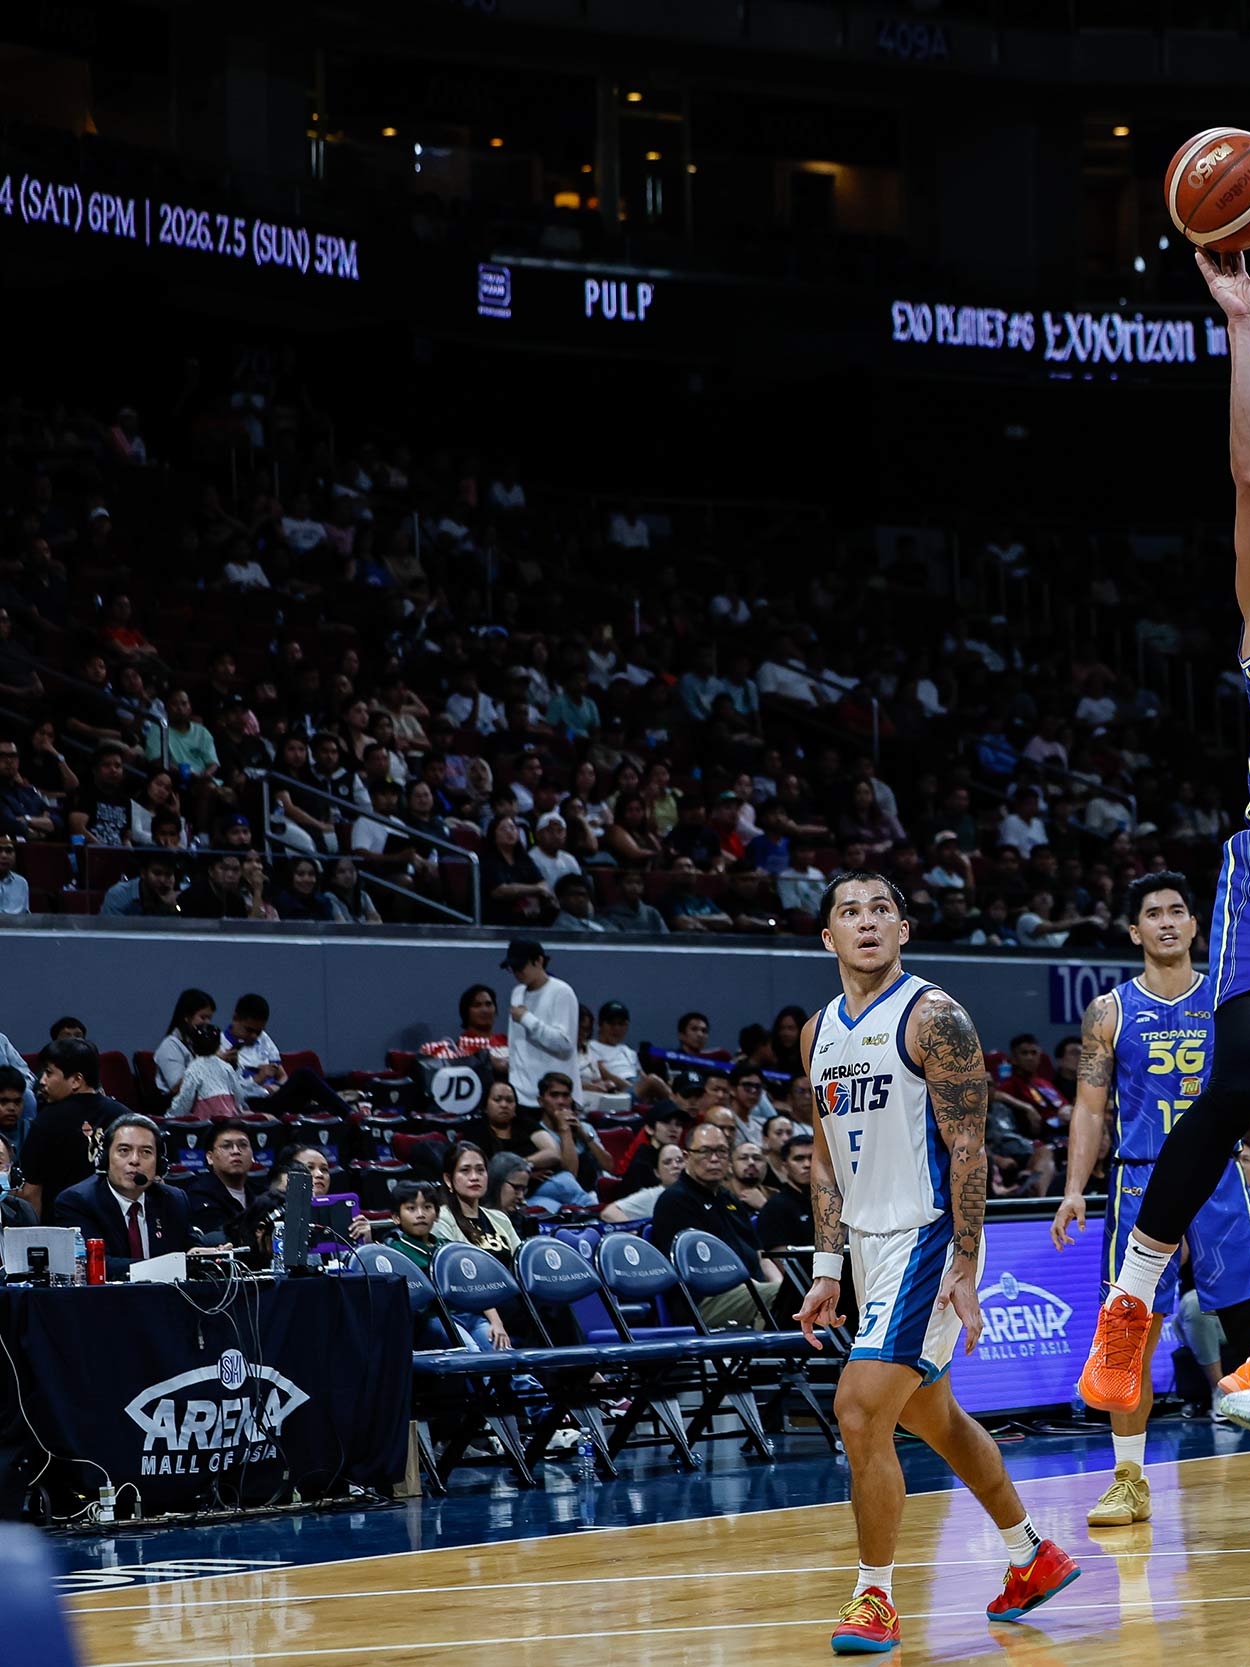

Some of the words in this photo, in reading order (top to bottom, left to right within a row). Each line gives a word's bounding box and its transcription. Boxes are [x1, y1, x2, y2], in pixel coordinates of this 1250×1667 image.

[20, 173, 83, 233] (SAT)
[88, 191, 136, 239] 6PM
[159, 203, 246, 258] 2026.7.5
[252, 218, 310, 275] (SUN)
[314, 233, 359, 281] 5PM
[585, 278, 652, 321] PULP
[892, 300, 933, 343] EXO
[1140, 1029, 1207, 1041] TROPANG
[820, 1062, 870, 1081] MERALCO
[1147, 1039, 1205, 1075] 5G
[440, 1076, 475, 1103] JD
[979, 1303, 1069, 1345] ARENA
[1020, 1343, 1038, 1357] OF
[1041, 1340, 1073, 1356] ASIA
[143, 1388, 283, 1451] ARENA
[141, 1455, 200, 1475] MALL
[208, 1451, 234, 1472] OF
